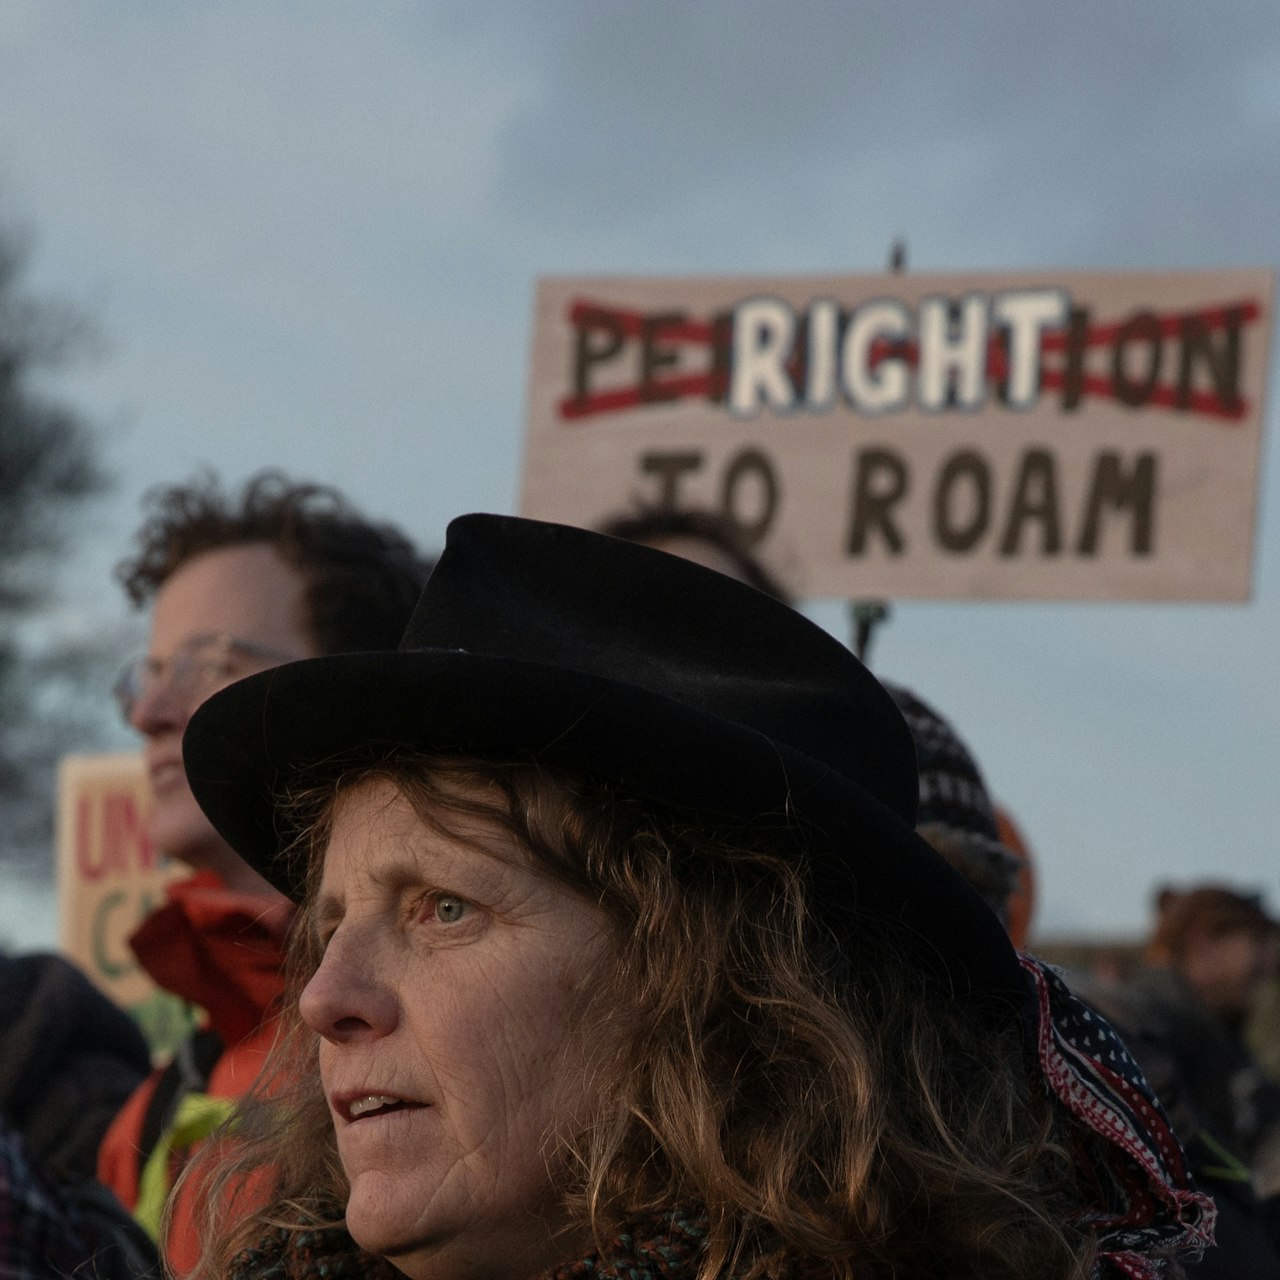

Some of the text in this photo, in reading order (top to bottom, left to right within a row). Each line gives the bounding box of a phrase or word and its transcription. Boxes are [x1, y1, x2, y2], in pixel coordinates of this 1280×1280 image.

[728, 292, 1066, 412] RIGHT
[638, 445, 1158, 558] TO ROAM
